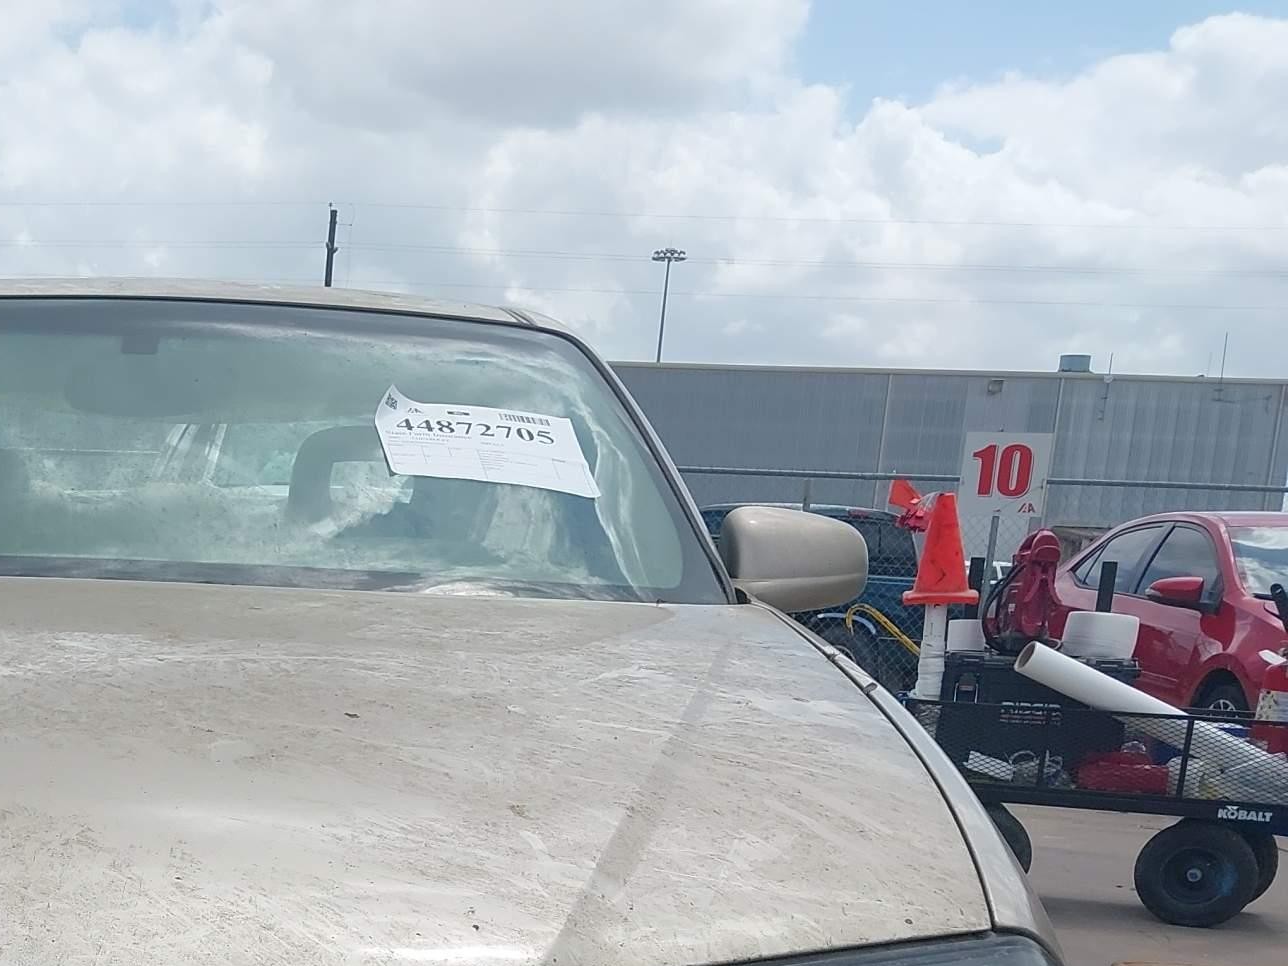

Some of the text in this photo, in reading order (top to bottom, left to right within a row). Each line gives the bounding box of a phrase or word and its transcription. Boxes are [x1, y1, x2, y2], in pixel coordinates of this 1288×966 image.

[396, 418, 554, 445] 44872705
[972, 443, 1034, 499] 10
[1217, 805, 1273, 822] KOBALT
